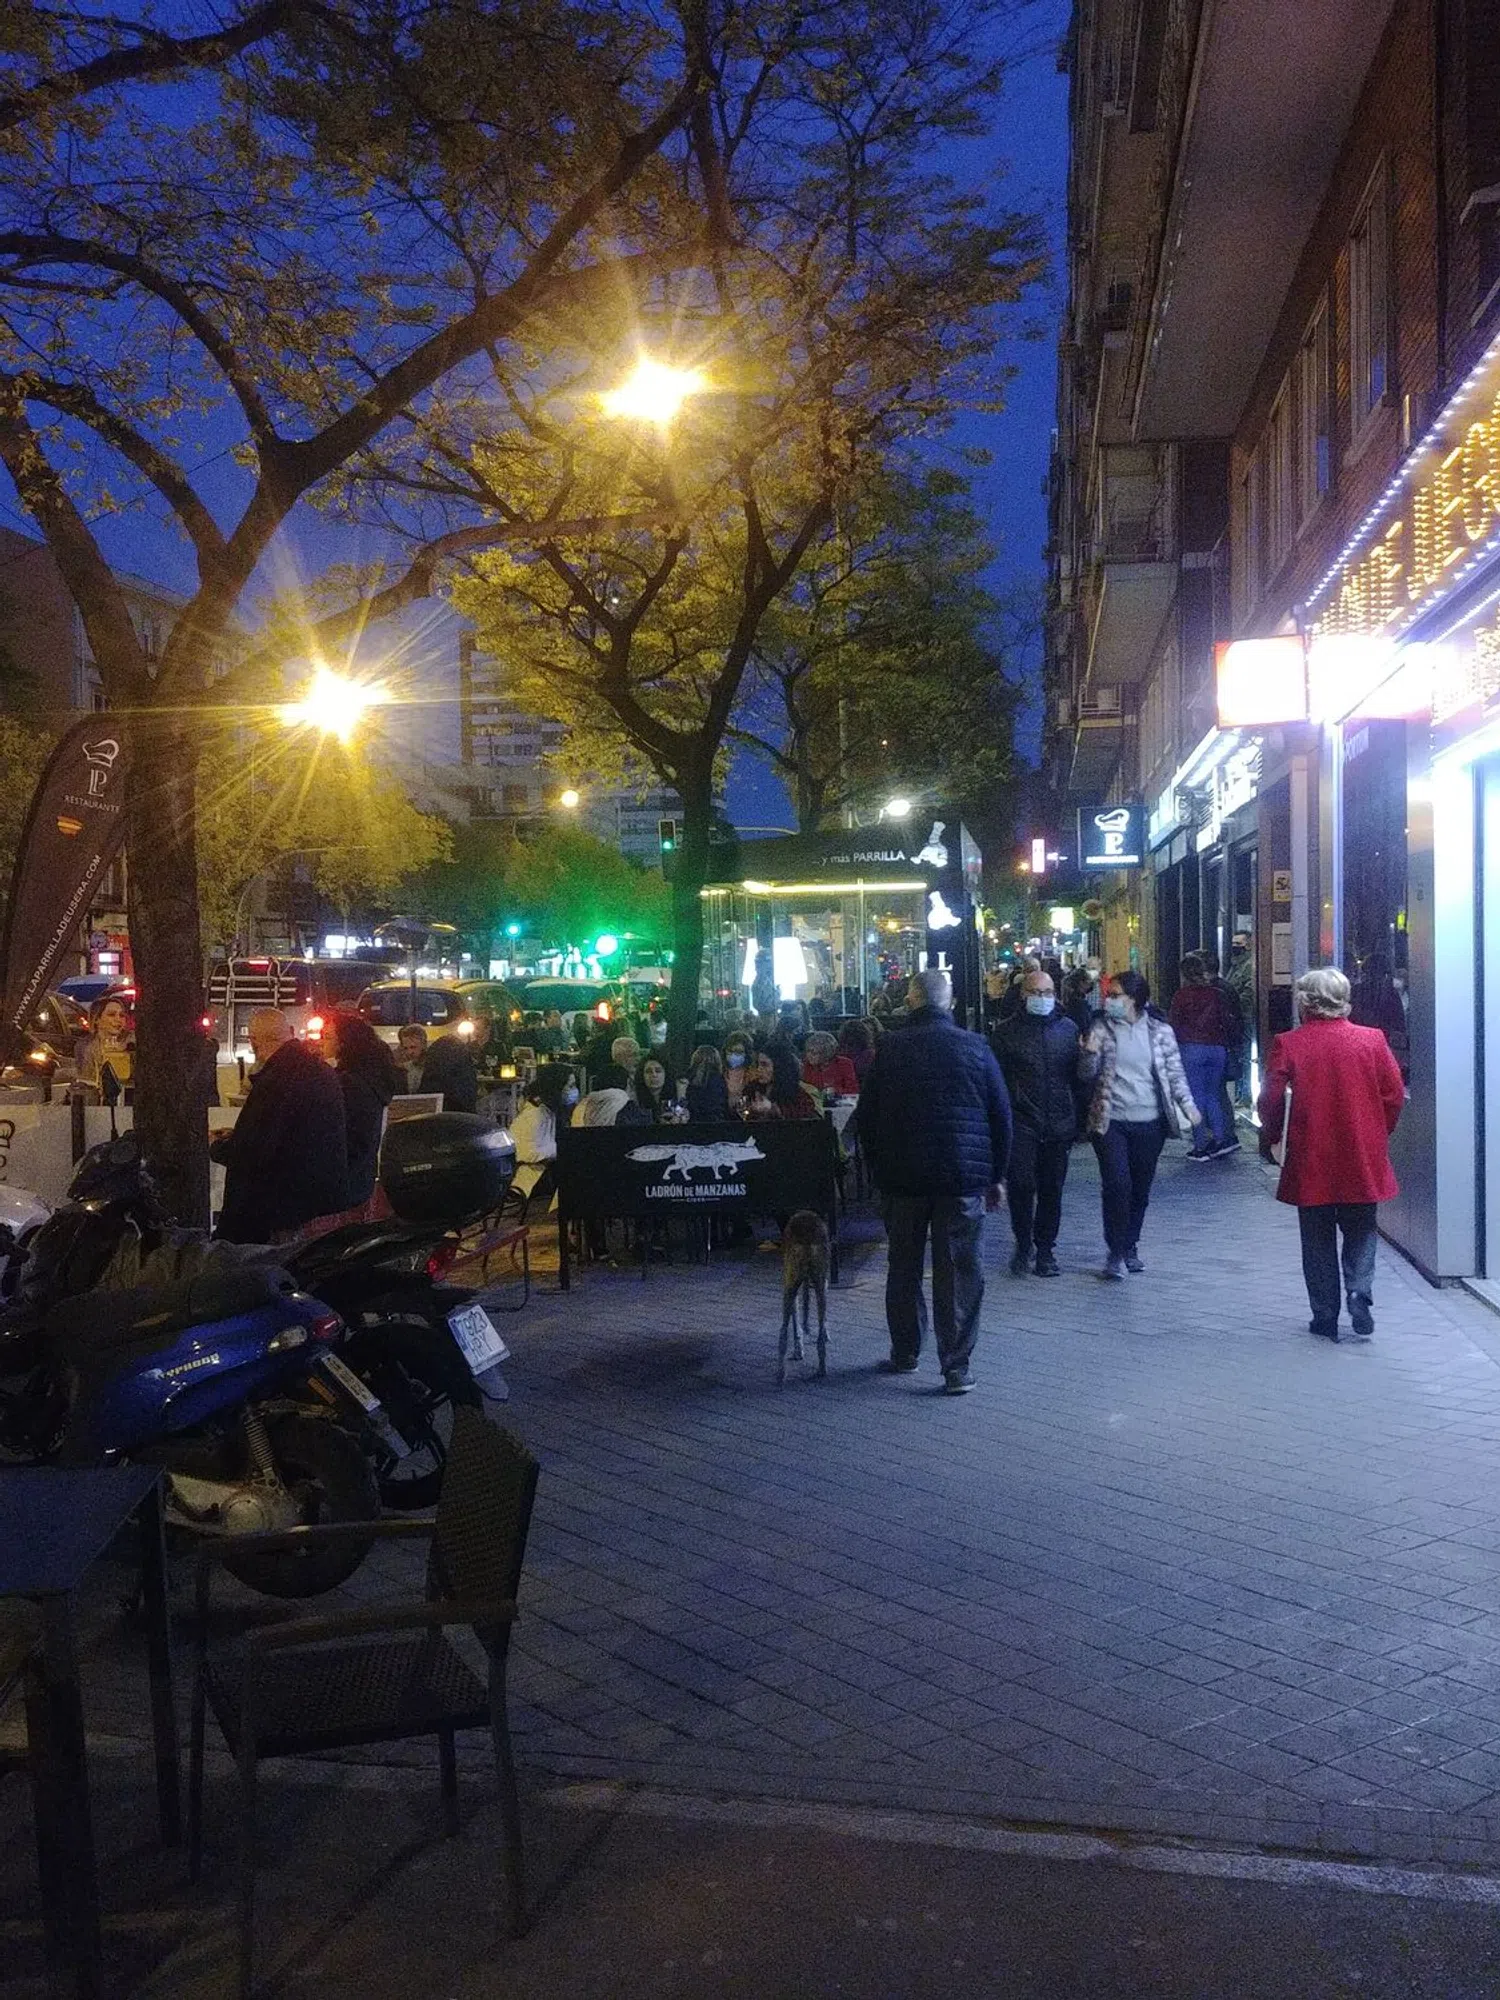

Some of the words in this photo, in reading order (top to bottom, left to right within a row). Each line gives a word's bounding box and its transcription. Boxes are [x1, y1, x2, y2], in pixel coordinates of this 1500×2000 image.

[63, 794, 121, 813] RESTAURANTE
[853, 849, 906, 863] PARRILLA
[645, 1183, 683, 1198] LADRÓN
[684, 1187, 694, 1197] DE
[695, 1183, 747, 1197] MANZANAS
